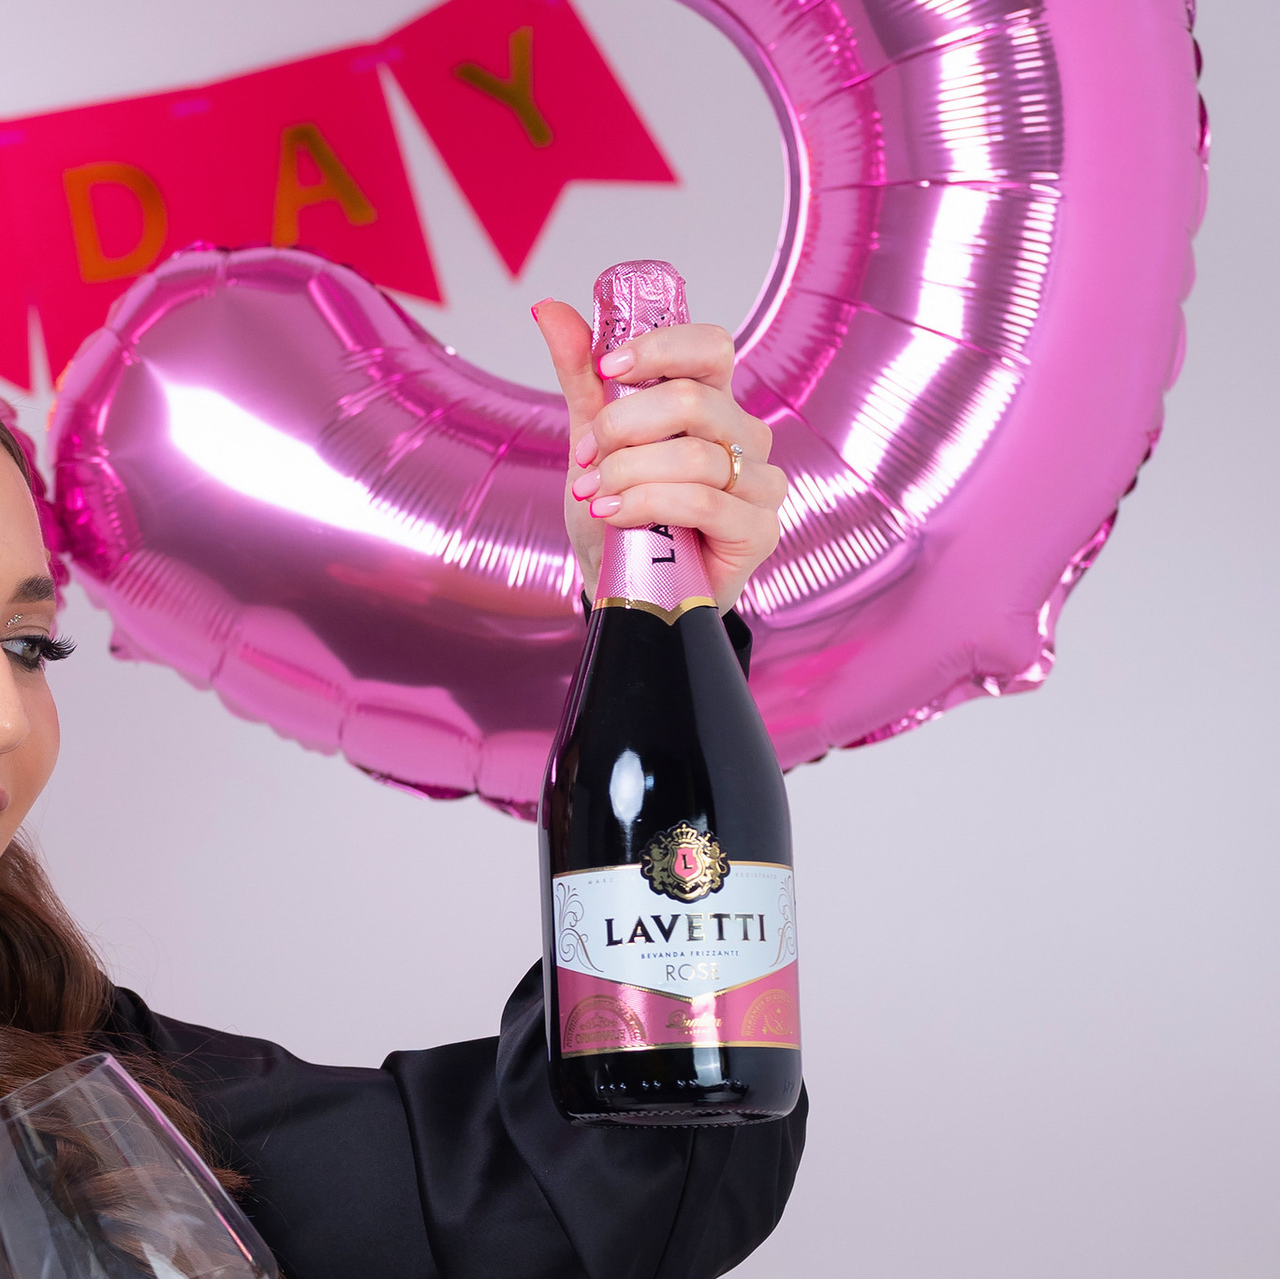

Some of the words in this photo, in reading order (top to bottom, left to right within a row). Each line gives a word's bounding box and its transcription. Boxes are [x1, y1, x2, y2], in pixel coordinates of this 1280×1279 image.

[681, 853, 694, 870] L
[604, 912, 768, 948] LAVETTI
[640, 951, 686, 960] BEVANDA
[689, 950, 740, 958] FRIZZANTE
[665, 962, 720, 981] ROSE
